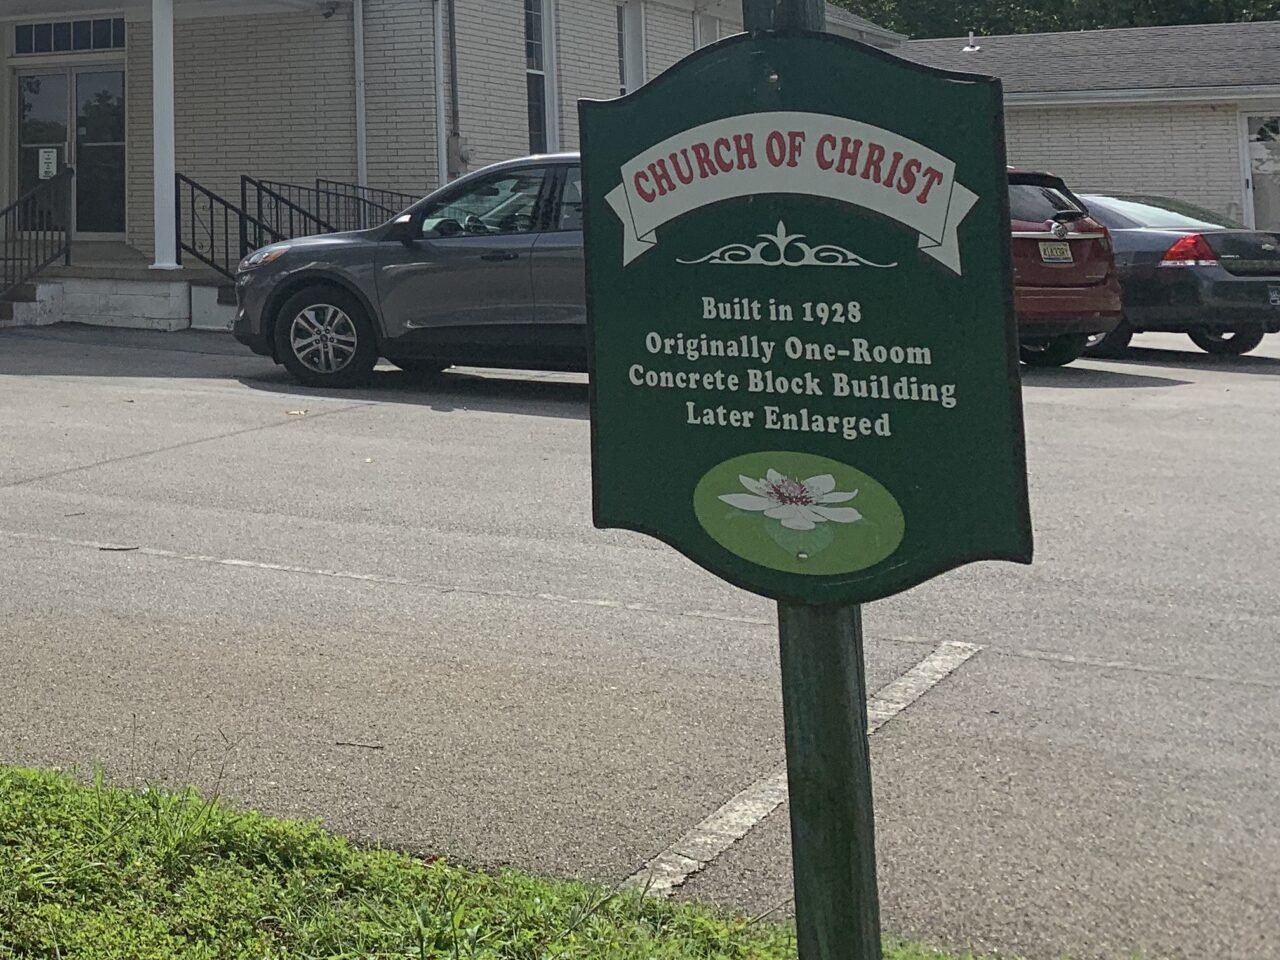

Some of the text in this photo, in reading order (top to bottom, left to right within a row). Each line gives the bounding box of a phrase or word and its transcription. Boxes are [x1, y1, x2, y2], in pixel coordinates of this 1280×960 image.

[634, 130, 943, 204] CHURCH OF CHRIST
[701, 296, 862, 325] Built in 1928
[645, 331, 932, 365] Originally One-Room
[628, 364, 957, 408] Concrete Block Building
[685, 401, 892, 440] Later Enlarged
